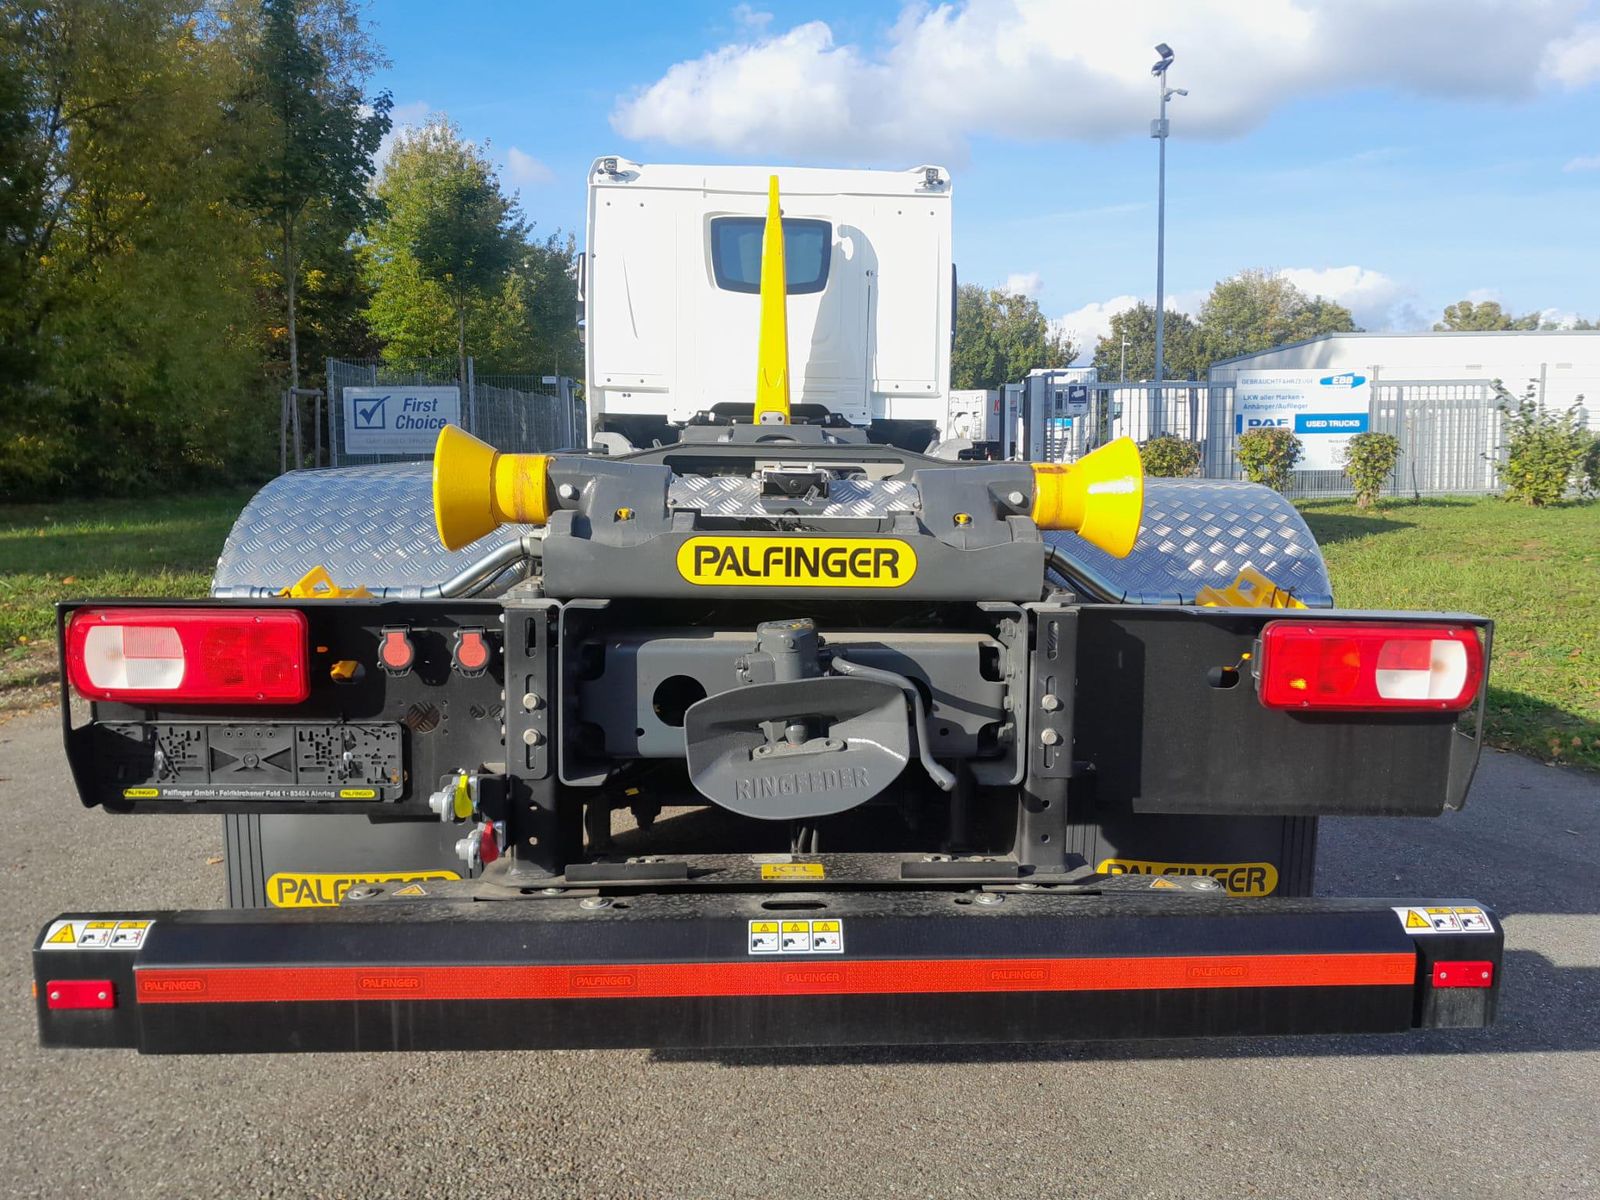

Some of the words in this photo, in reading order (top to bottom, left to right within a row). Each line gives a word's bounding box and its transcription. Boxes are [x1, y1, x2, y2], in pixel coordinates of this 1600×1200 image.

[403, 397, 438, 412] First
[395, 414, 447, 430] Choice
[1248, 418, 1288, 427] DAF
[1305, 420, 1327, 428] USED
[1329, 419, 1360, 428] TRUCKS
[694, 545, 899, 579] PALFINGER
[735, 766, 871, 801] RINGFEDER
[162, 789, 193, 797] Palfinger
[194, 789, 215, 797] GmbH
[990, 969, 1044, 980] PALFINGER
[144, 980, 201, 991] PALFINGER
[362, 978, 418, 988] PALFINGER
[576, 975, 631, 986] PALFINGER
